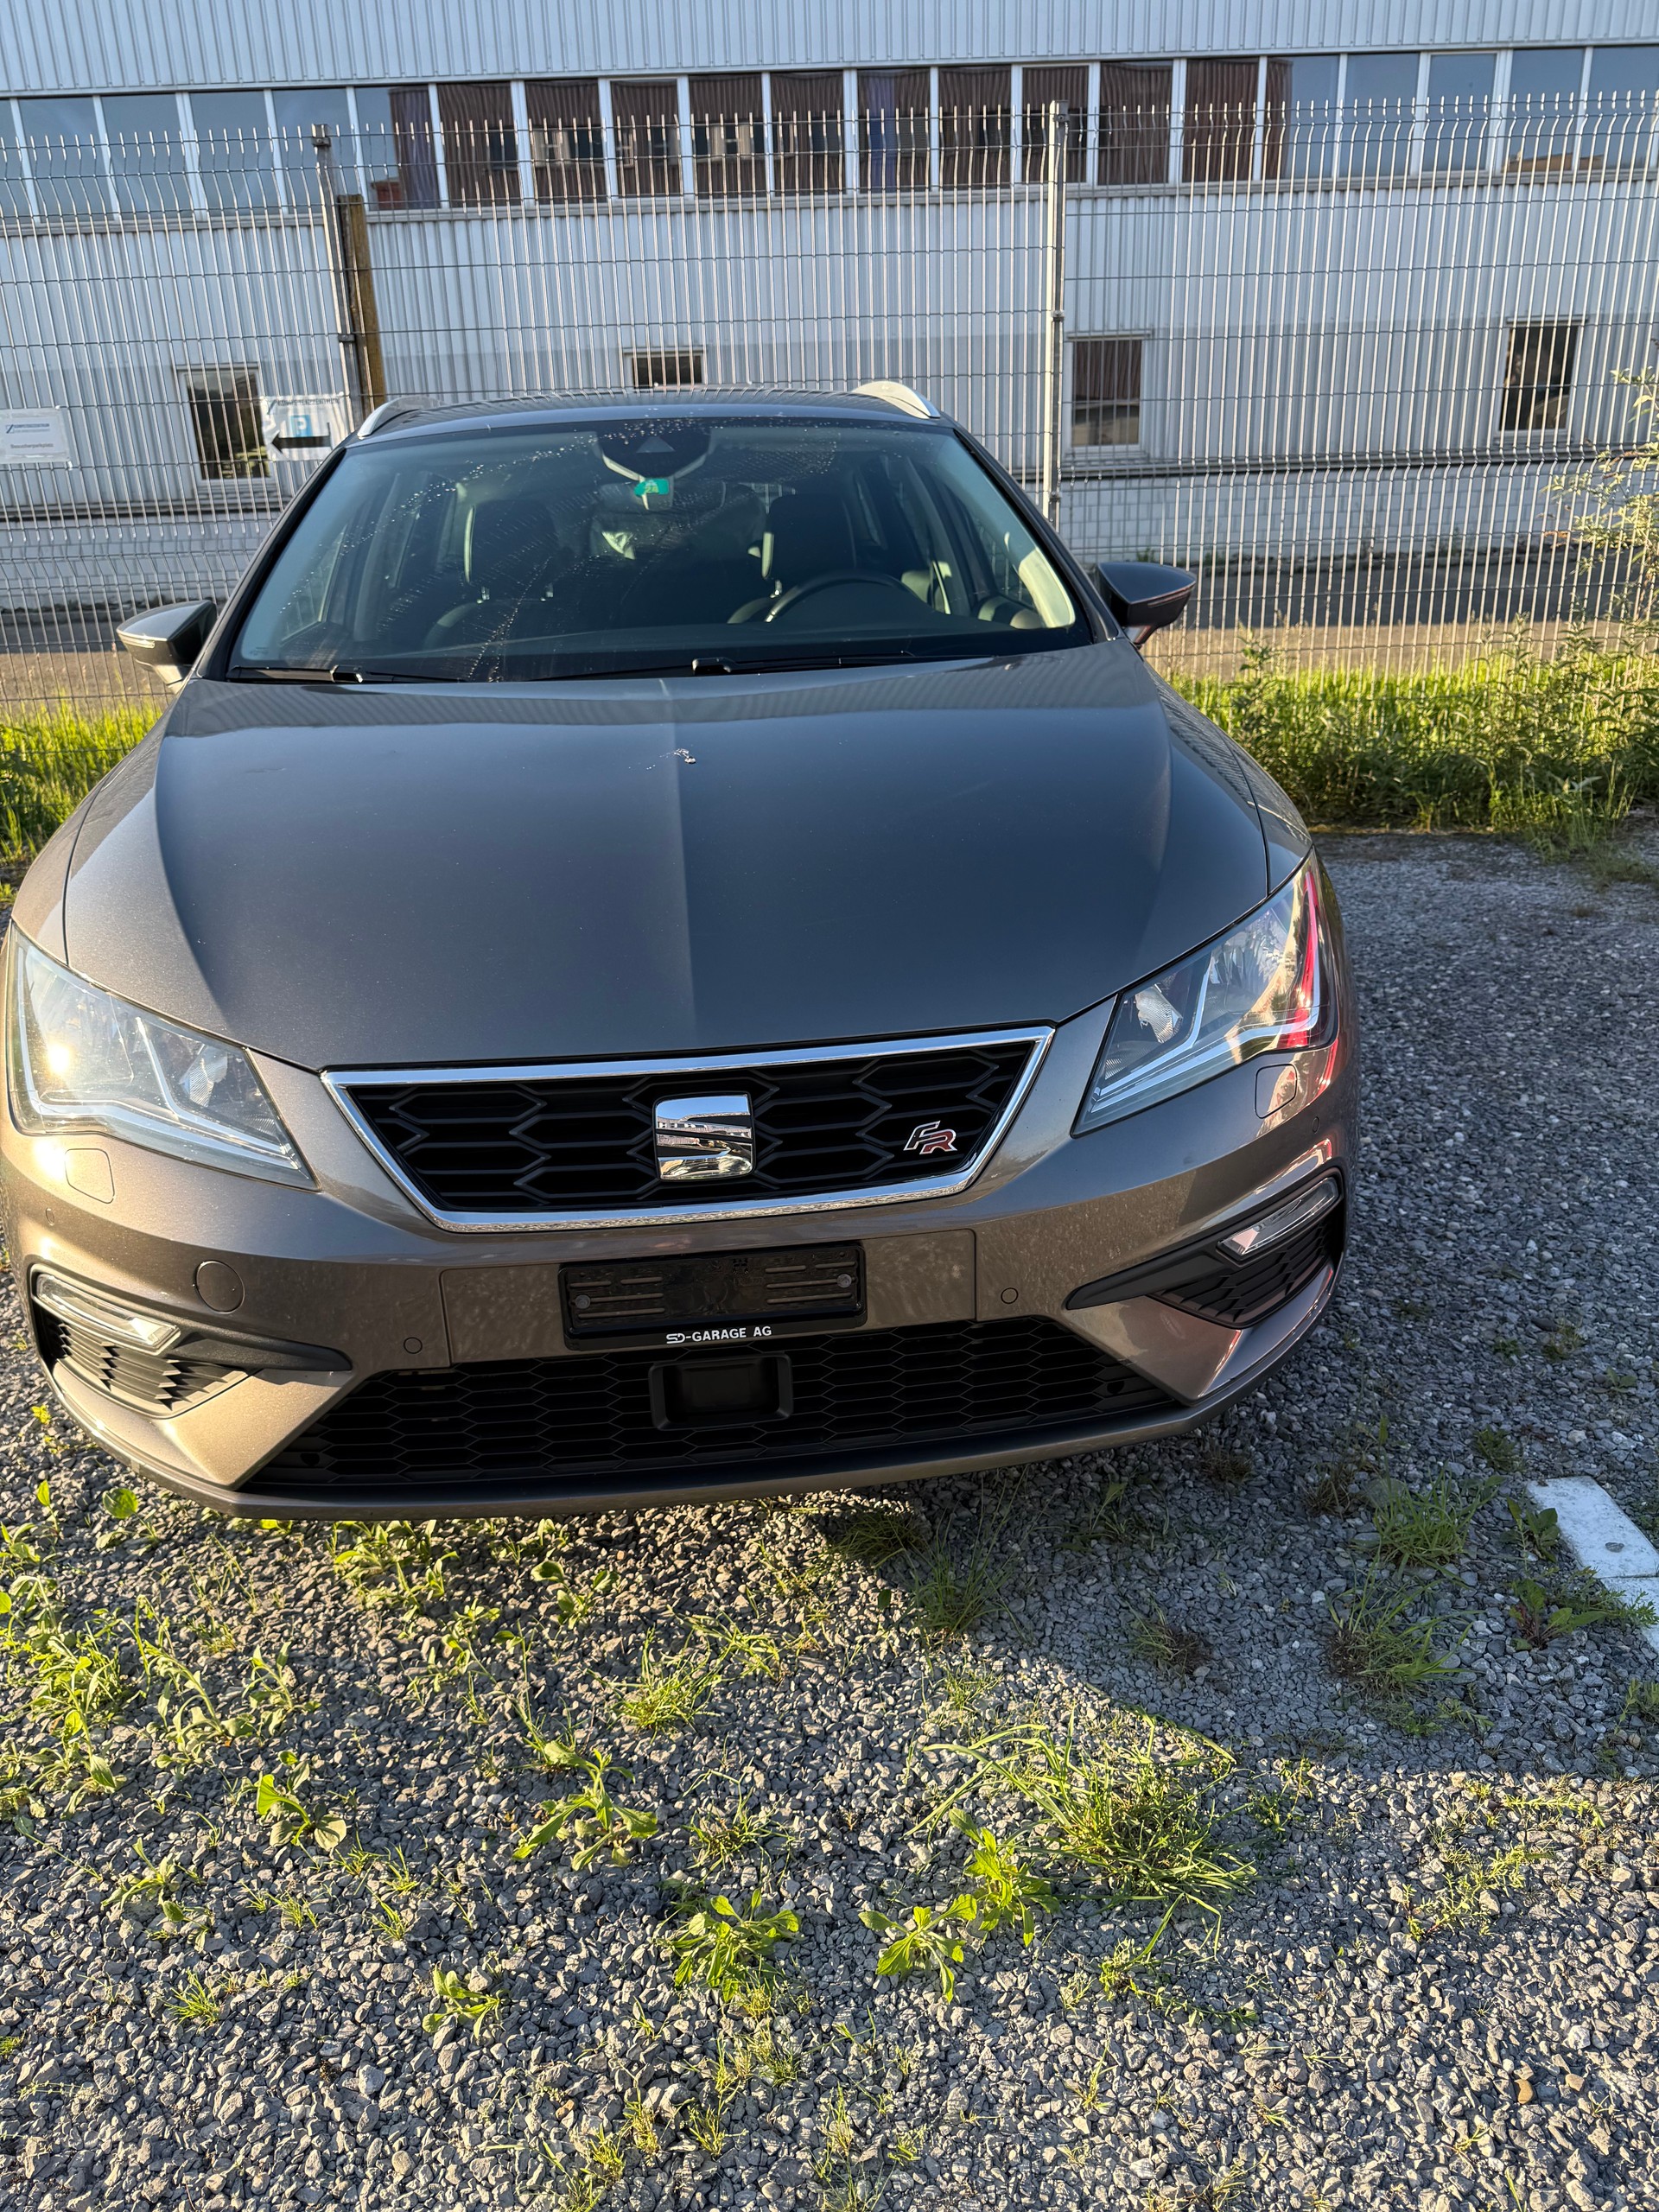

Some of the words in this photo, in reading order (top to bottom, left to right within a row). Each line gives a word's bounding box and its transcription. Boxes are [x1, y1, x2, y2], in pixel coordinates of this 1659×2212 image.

[903, 1120, 957, 1154] FR
[666, 1327, 746, 1344] SD-GARAGE
[753, 1325, 772, 1337] AG
